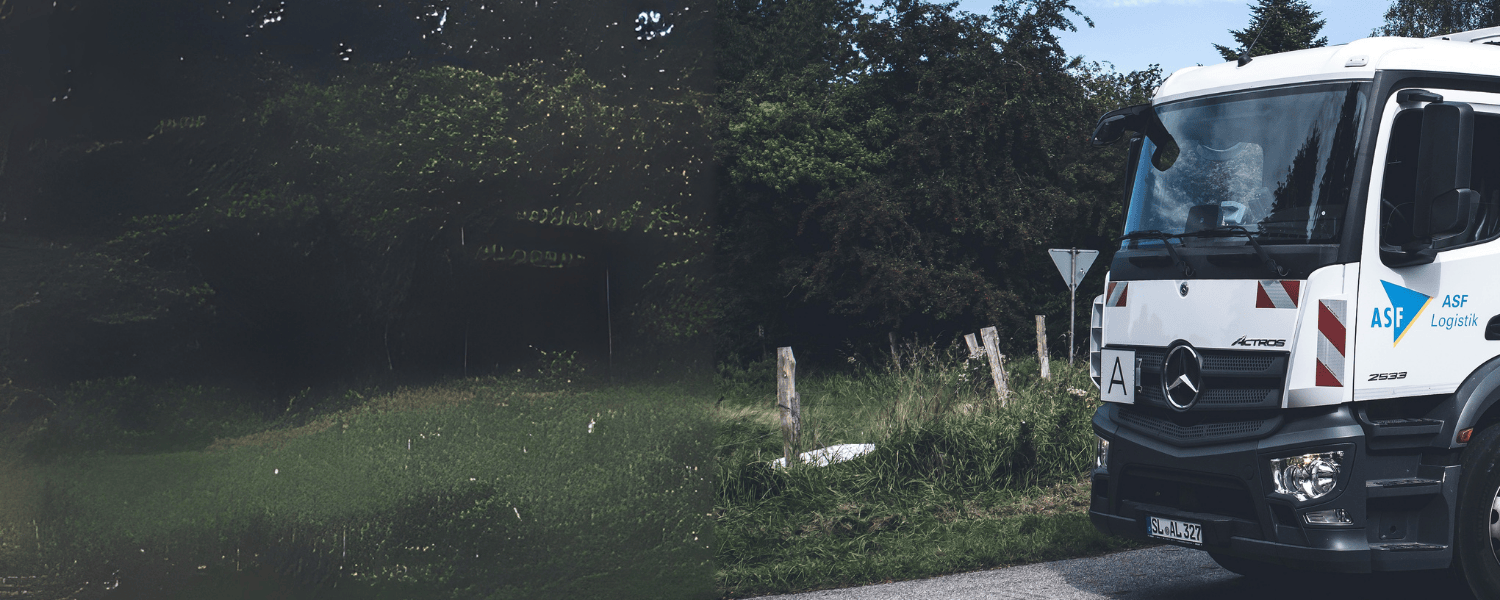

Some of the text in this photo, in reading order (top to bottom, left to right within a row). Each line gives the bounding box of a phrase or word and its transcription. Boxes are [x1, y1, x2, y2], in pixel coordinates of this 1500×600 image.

[1442, 294, 1468, 308] ASF
[1371, 307, 1404, 328] ASF
[1431, 313, 1479, 330] Logistik
[1231, 334, 1286, 347] ACTROS
[1108, 356, 1127, 396] A
[1367, 371, 1407, 382] 2533
[1151, 518, 1201, 541] SL AL 327
